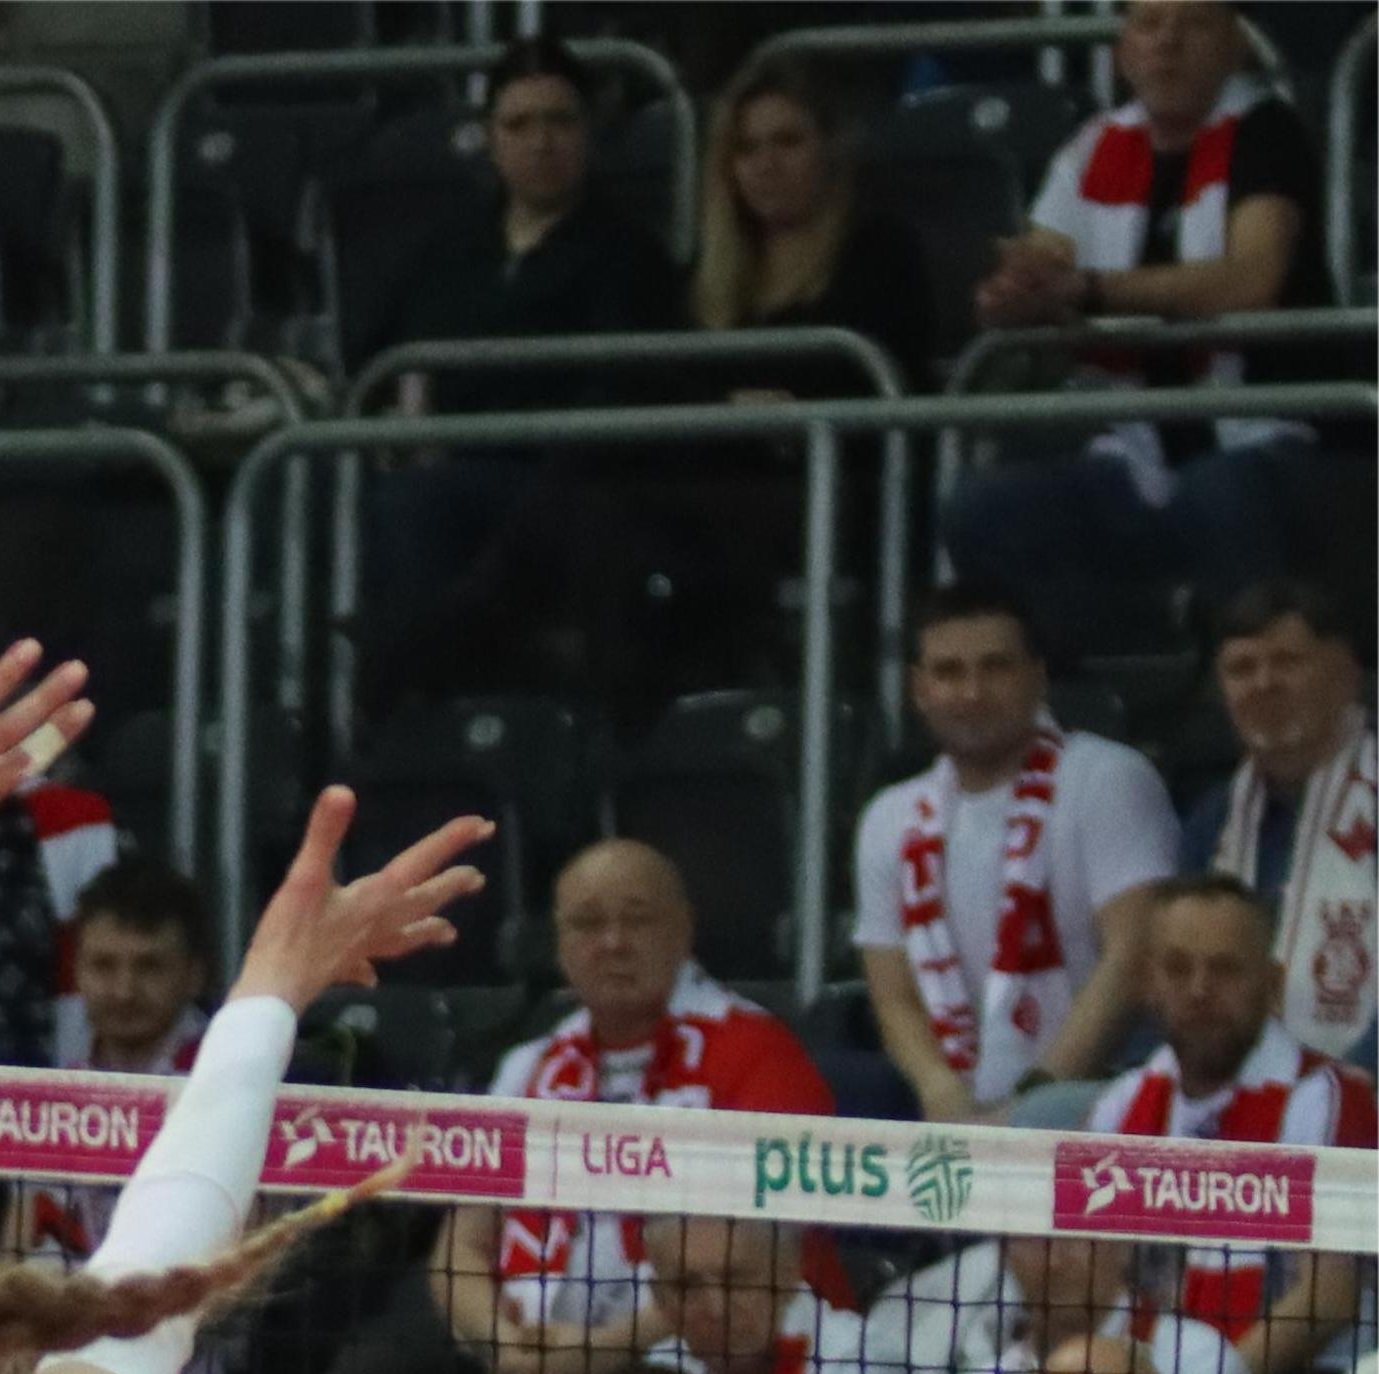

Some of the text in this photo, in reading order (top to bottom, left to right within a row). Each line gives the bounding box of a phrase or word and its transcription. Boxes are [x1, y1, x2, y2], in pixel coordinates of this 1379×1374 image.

[340, 1118, 502, 1170] TAURON
[583, 1132, 672, 1179] LIGA
[754, 1133, 888, 1208] plus
[1133, 1167, 1289, 1214] TAURON
